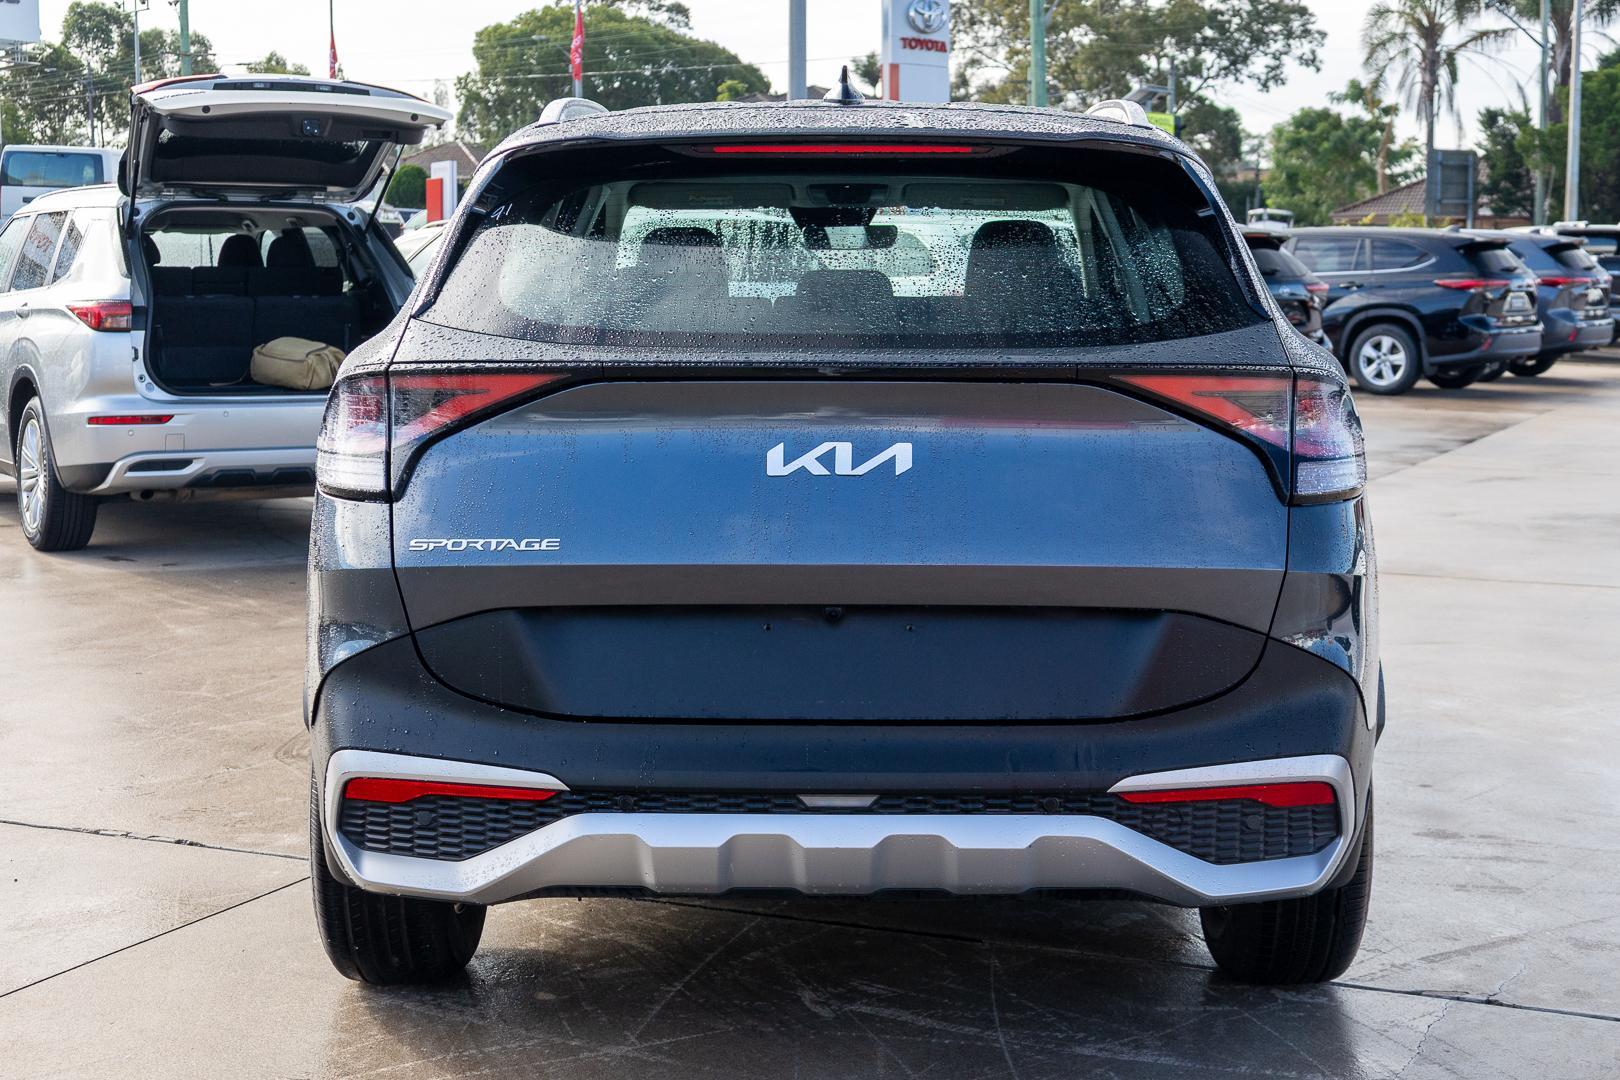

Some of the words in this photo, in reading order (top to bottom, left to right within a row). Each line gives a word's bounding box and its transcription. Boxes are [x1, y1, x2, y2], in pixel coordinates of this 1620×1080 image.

[900, 37, 947, 53] TOYOTA
[766, 441, 913, 477] KIA
[408, 538, 561, 551] SPORTAGE
